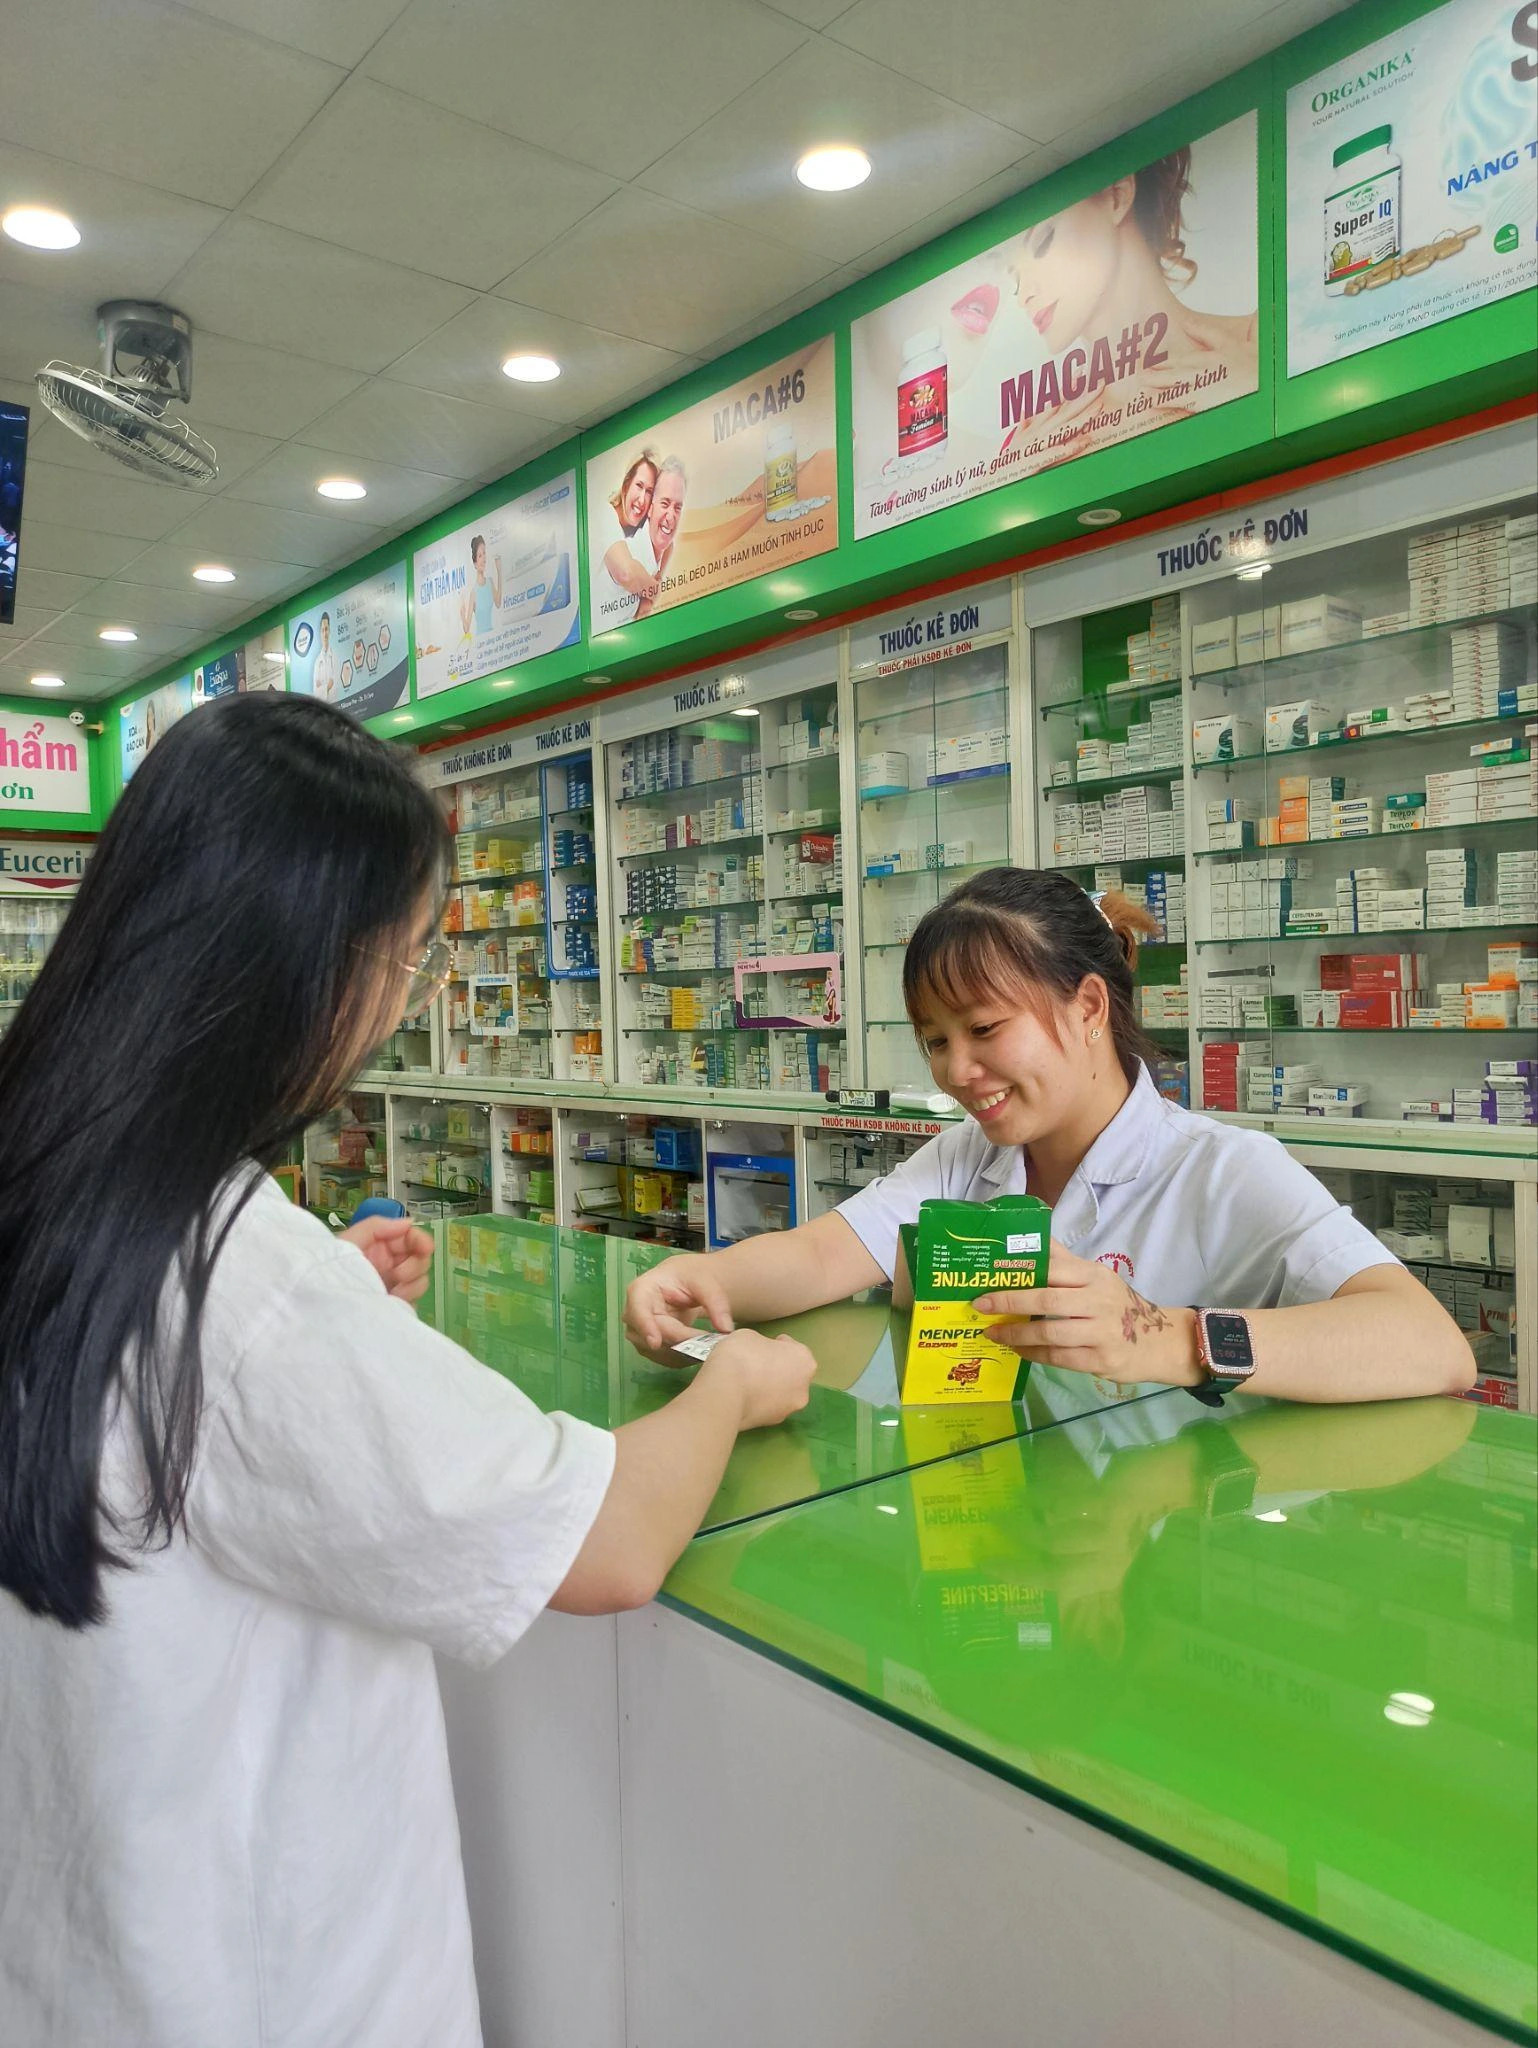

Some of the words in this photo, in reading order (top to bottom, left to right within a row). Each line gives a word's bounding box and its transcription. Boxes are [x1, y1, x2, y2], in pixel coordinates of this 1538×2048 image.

[1311, 52, 1412, 113] ORGANIKA
[1312, 112, 1333, 127] YOUR
[1334, 95, 1370, 117] NATURAL
[1372, 71, 1415, 97] SOLUTION
[1334, 209, 1375, 238] Super
[1379, 198, 1393, 219] IQ
[1001, 312, 1170, 430] MACA#2
[713, 368, 806, 443] MACA#6
[869, 499, 894, 518] Tăng
[895, 485, 927, 508] cường
[955, 466, 967, 487] lý
[989, 448, 1022, 475] giảm
[1023, 438, 1045, 458] các
[1048, 424, 1078, 447] triệu
[1081, 407, 1123, 434] chứng
[1126, 391, 1153, 417] tiền
[1156, 380, 1192, 407] mãn
[1193, 363, 1228, 393] kinh
[1157, 527, 1223, 577] THUỐC
[1228, 518, 1256, 556] KÊ
[1263, 508, 1308, 546] ĐƠN
[707, 559, 722, 575] DAI
[723, 556, 729, 568] &
[730, 548, 750, 566] HAM
[878, 616, 923, 656] THUỐC
[926, 611, 945, 642] KÊ
[949, 605, 980, 633] ĐƠN
[673, 681, 706, 713] THUỐC
[707, 678, 721, 703] KÊ
[535, 725, 561, 751] THUỐC
[562, 722, 573, 744] KÊ
[574, 718, 591, 741] ĐƠN
[442, 751, 463, 776] THUỐC
[463, 749, 486, 771] KHÔNG
[486, 744, 497, 763] KÊ
[497, 741, 512, 762] ĐƠN
[821, 1115, 844, 1128] THUỐC
[845, 1117, 862, 1129] PHẢI
[884, 1119, 911, 1132] KHÔNG
[911, 1121, 923, 1133] KÊ
[924, 1123, 941, 1134] ĐƠN
[931, 1271, 1036, 1288] MENPEPTINE
[993, 1259, 1037, 1270] Enzyme
[917, 1341, 958, 1349] Enzyme
[918, 1328, 984, 1340] MENPEP
